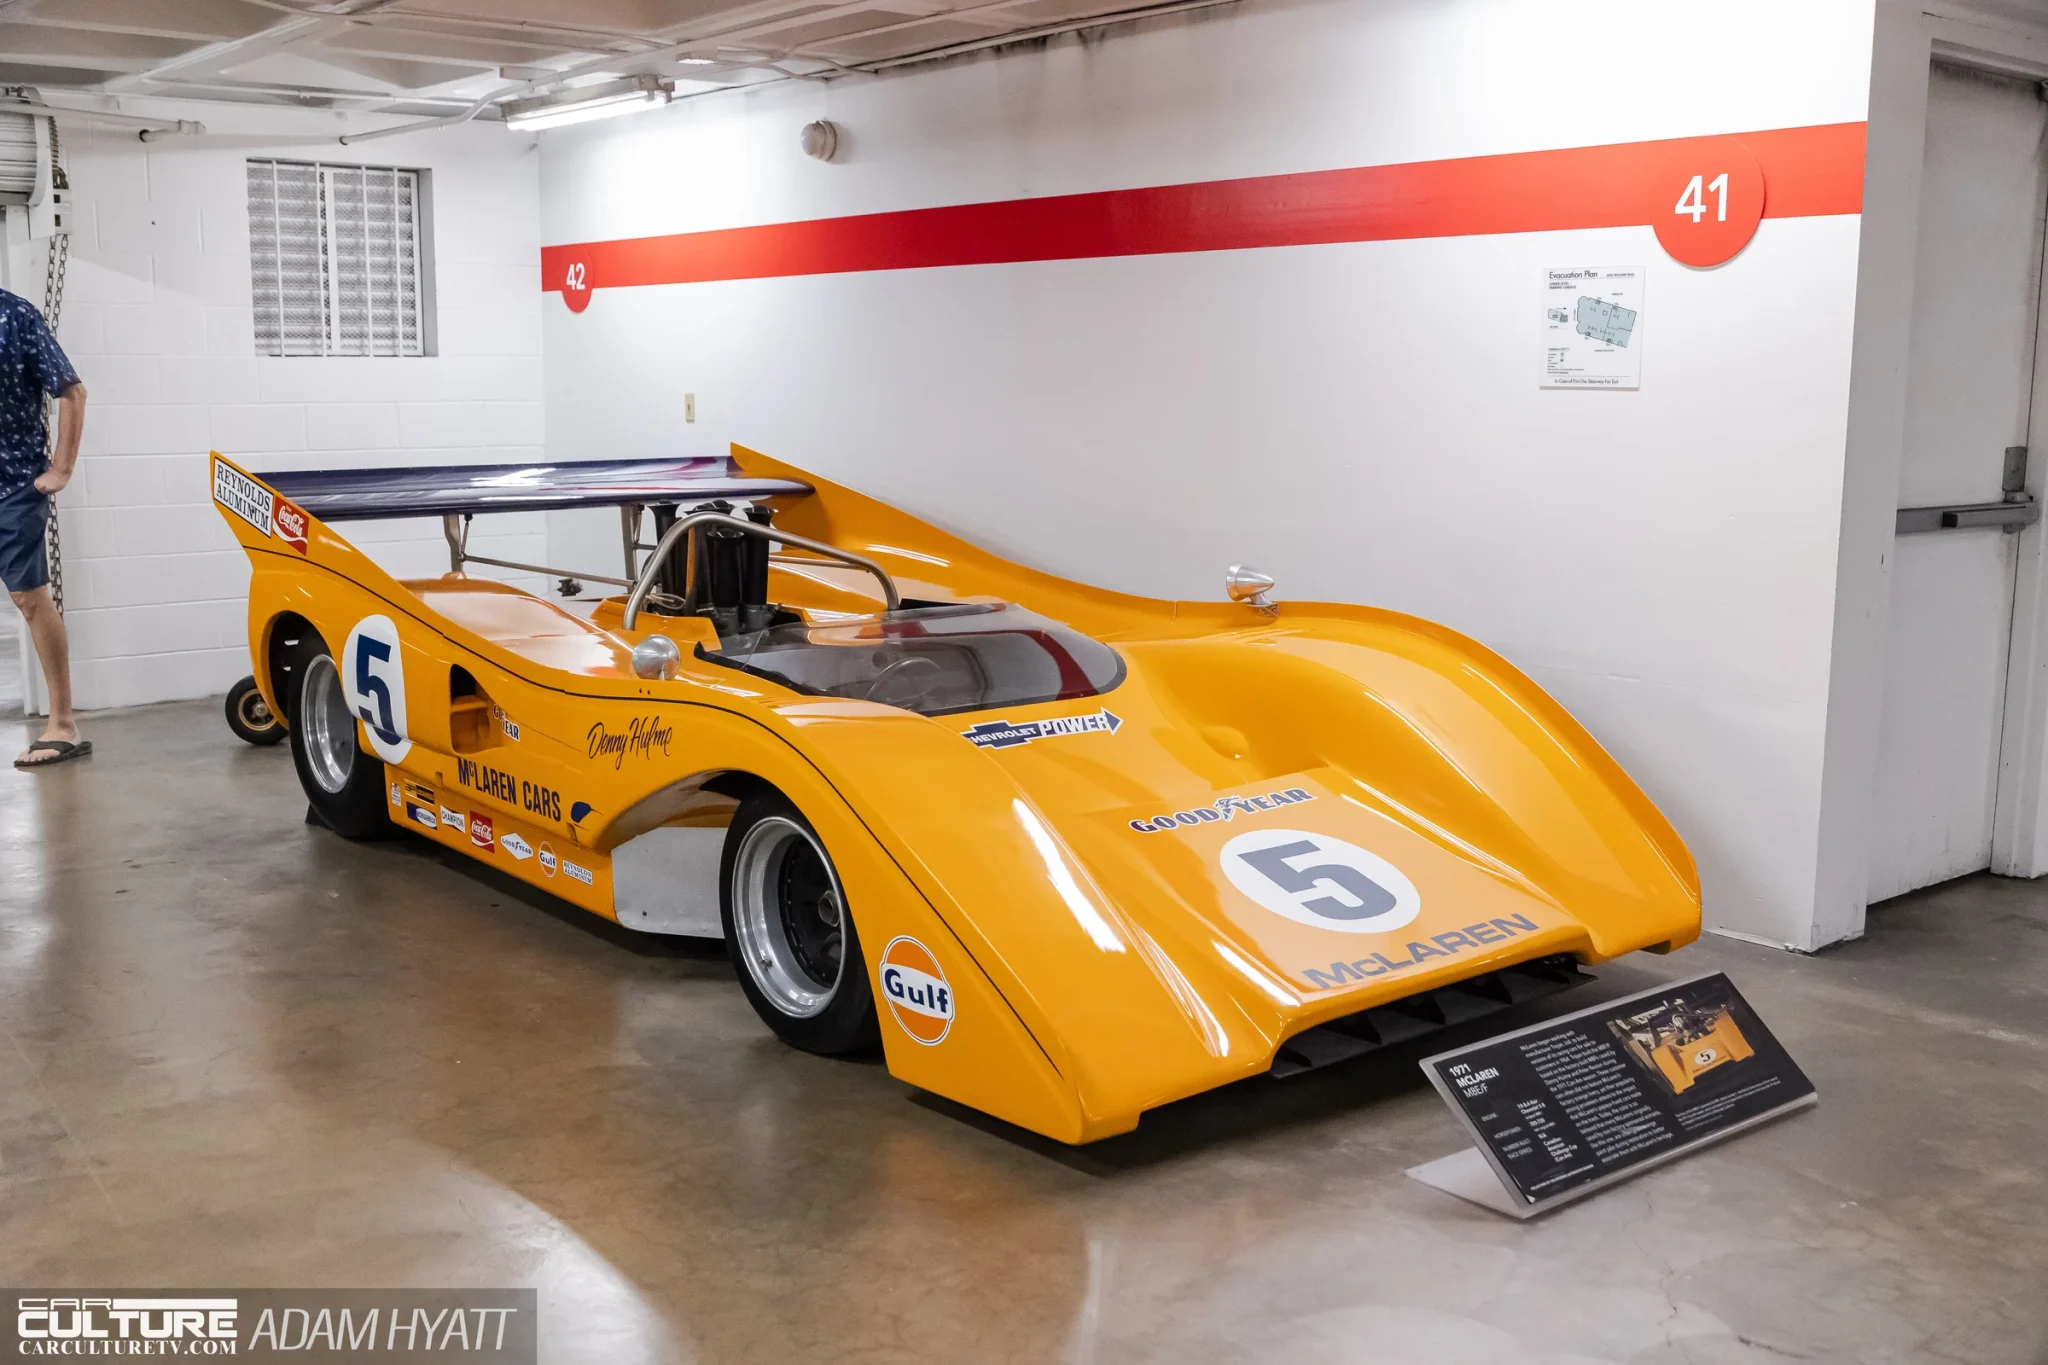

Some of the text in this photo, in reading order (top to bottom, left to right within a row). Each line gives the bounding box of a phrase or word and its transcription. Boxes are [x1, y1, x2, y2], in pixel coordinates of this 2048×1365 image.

[1674, 172, 1728, 223] 41
[566, 262, 586, 290] 42
[1549, 270, 1582, 279] Evacuation
[1584, 270, 1598, 278] Plan
[217, 464, 271, 512] REYNOLDS
[216, 483, 269, 531] ALUMINUM
[278, 505, 304, 537] Coca-Cola
[356, 633, 402, 746] 5
[1038, 715, 1109, 737] POWER
[587, 711, 673, 770] Denny Hulme
[522, 781, 561, 822] CARS
[441, 810, 464, 827] CHAMPION
[539, 852, 556, 867] Gulf
[563, 861, 592, 878] REYNOLDS
[564, 867, 592, 884] ALUMINUM
[1237, 839, 1397, 920] 5
[884, 968, 949, 1014] Gulf
[1519, 1041, 1538, 1051] McLaren
[1536, 1037, 1552, 1047] began
[1549, 1032, 1567, 1042] working
[1524, 1045, 1552, 1058] manufacturer
[1575, 1033, 1587, 1041] build
[1528, 1055, 1547, 1064] versions
[1554, 1047, 1570, 1057] racing
[1533, 1060, 1556, 1071] customers
[1569, 1051, 1584, 1060] Trojan
[1538, 1070, 1553, 1078] based
[1597, 1050, 1610, 1058] raced
[1699, 1052, 1711, 1062] 5
[1447, 1062, 1471, 1077] 1971
[1455, 1066, 1499, 1087] MCLAREN
[1543, 1076, 1560, 1086] Denny
[1556, 1072, 1571, 1081] Hulme
[1601, 1056, 1617, 1066] during
[1595, 1067, 1609, 1076] These
[1606, 1061, 1626, 1072] customer
[1462, 1082, 1490, 1097] M8E/F
[1558, 1075, 1636, 1107] factory orange yet their popularity
[1562, 1088, 1575, 1096] often
[1587, 1078, 1603, 1087] feature
[1600, 1072, 1621, 1082] McLaren's
[1520, 1104, 1539, 1114] Chevrolet
[1564, 1105, 1581, 1114] among
[1577, 1097, 1600, 1109] privateers
[1596, 1092, 1612, 1101] attests
[1621, 1083, 1637, 1093] impact
[1577, 1106, 1598, 1117] McLaren's
[1628, 1090, 1642, 1098] made
[1617, 1103, 1629, 1111] color
[1579, 1124, 1597, 1134] beloved
[1603, 1118, 1616, 1126] many
[1613, 1110, 1634, 1121] McLarens
[1631, 1104, 1652, 1116] originally
[1546, 1141, 1565, 1151] American
[1584, 1132, 1598, 1141] raced
[1589, 1141, 1599, 1149] like
[1596, 1138, 1606, 1146] this
[1619, 1129, 1632, 1137] often
[1594, 1147, 1608, 1157] paint
[1605, 1144, 1617, 1153] jobs
[1613, 1139, 1630, 1149] during
[1626, 1131, 1649, 1143] restoration
[1651, 1125, 1666, 1133] better
[1506, 1151, 1520, 1159] RACE
[1549, 1142, 1579, 1157] Challenge Cup
[1600, 1151, 1620, 1163] associate
[1617, 1147, 1630, 1156] them
[1628, 1144, 1638, 1152] with
[1636, 1137, 1657, 1148] McLaren's
